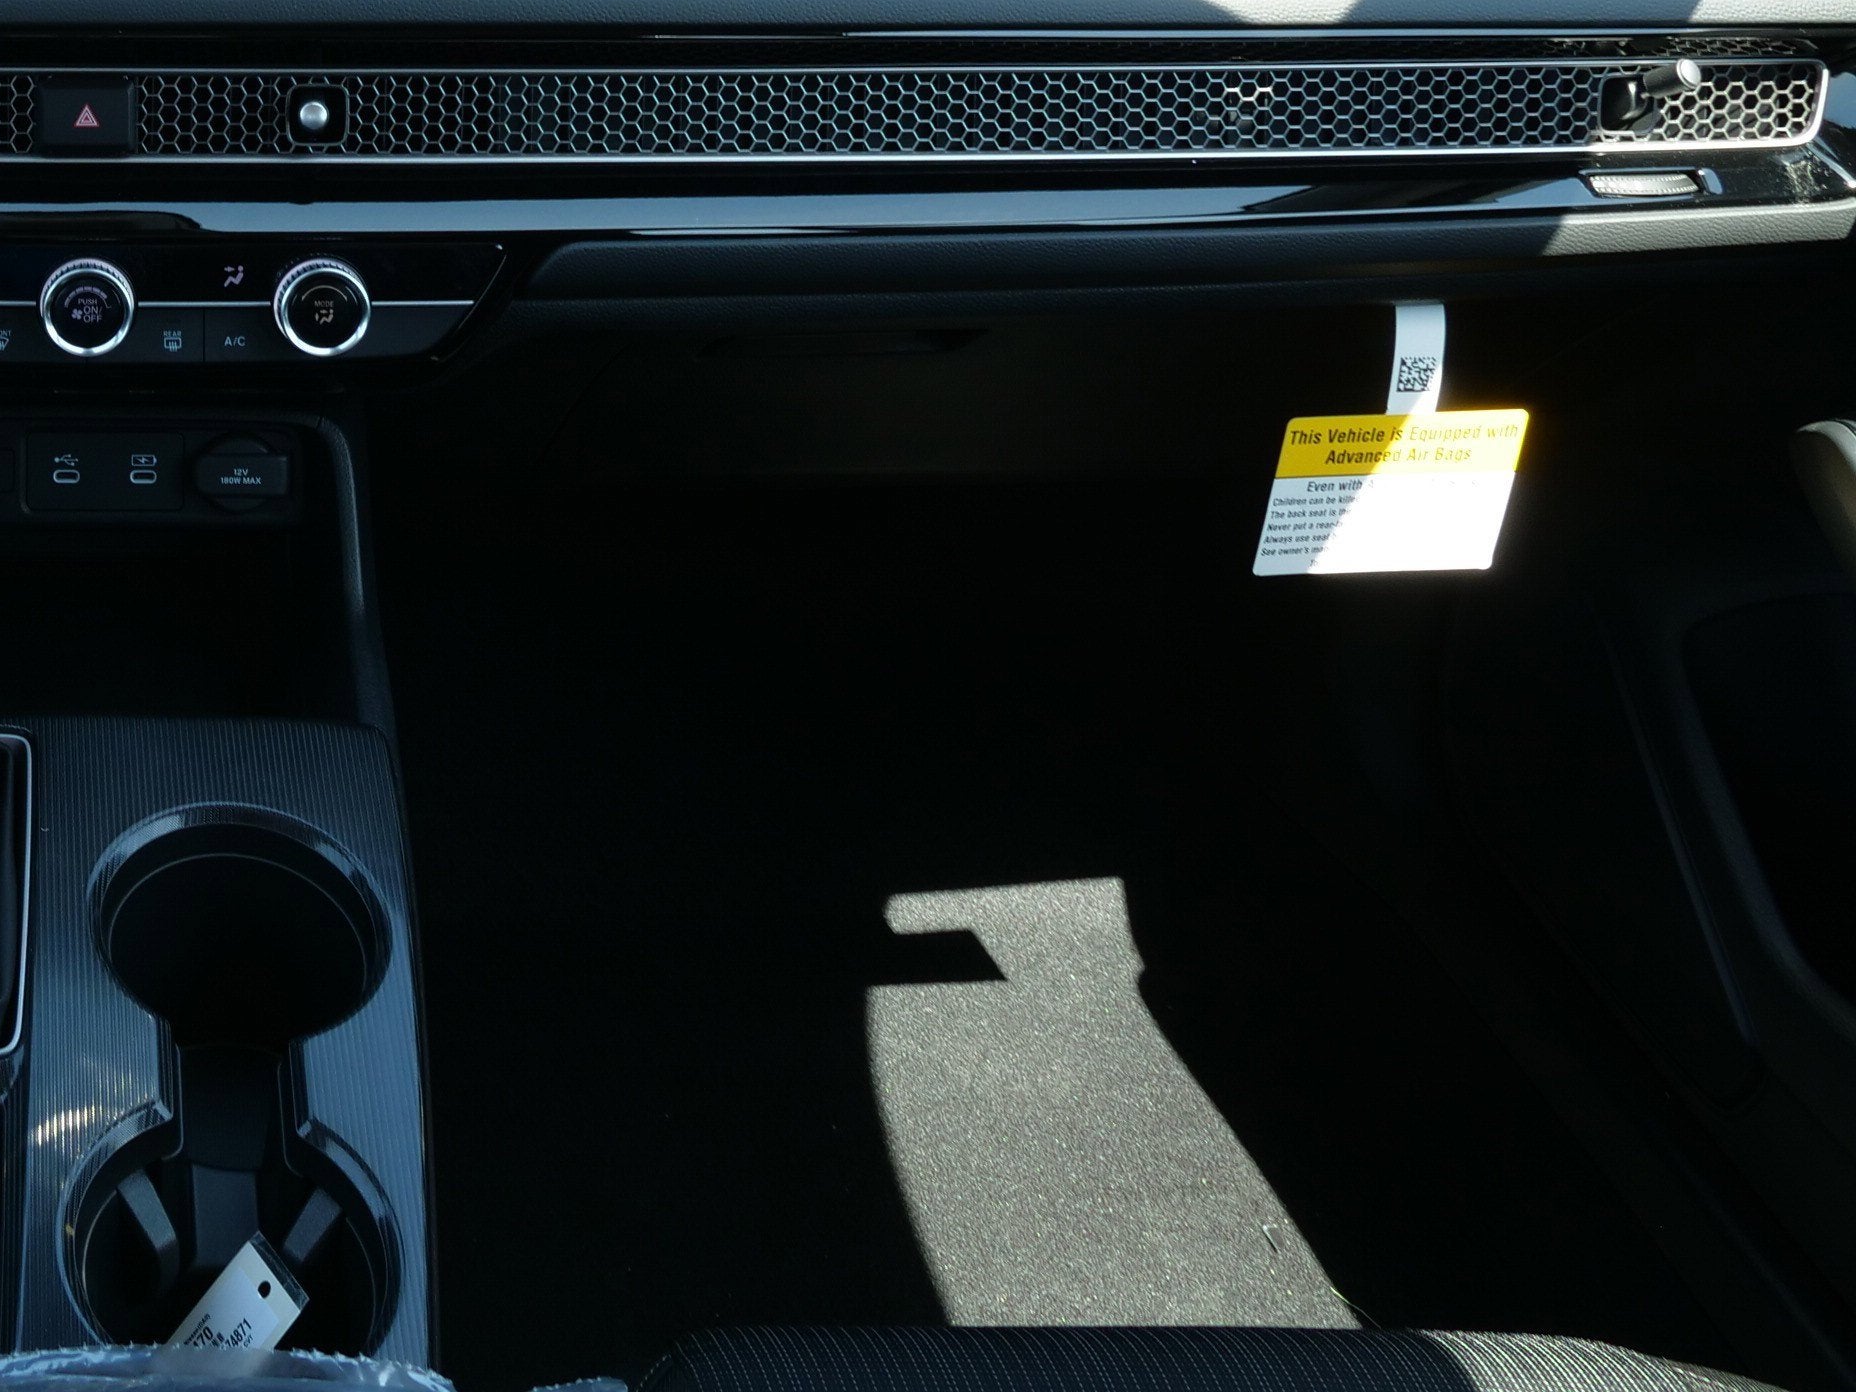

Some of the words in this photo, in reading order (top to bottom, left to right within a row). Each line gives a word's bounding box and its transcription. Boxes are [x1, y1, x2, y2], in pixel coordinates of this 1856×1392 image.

[78, 298, 97, 306] PUSH
[314, 300, 334, 308] MODE
[83, 314, 103, 323] OFF
[224, 336, 246, 348] A/C
[1290, 430, 1322, 446] This
[1328, 428, 1385, 444] Vehicle
[1390, 427, 1403, 441] is
[1410, 425, 1482, 442] Equipped
[1487, 423, 1519, 438] with
[1325, 449, 1402, 465] Advanced
[1408, 447, 1428, 462] Air
[1435, 447, 1473, 463] Bags
[233, 468, 249, 476] 12V
[242, 476, 261, 485] MAX
[1306, 481, 1335, 493] Even
[1339, 478, 1363, 491] with
[1273, 497, 1307, 507] Children
[1326, 496, 1336, 504] be
[1271, 510, 1285, 519] The
[1287, 510, 1306, 518] back
[1309, 509, 1327, 517] seat
[1267, 522, 1291, 531] Never
[1293, 522, 1307, 532] put
[1264, 535, 1293, 544] Always
[1261, 548, 1276, 557] See
[1278, 547, 1310, 555] owner's
